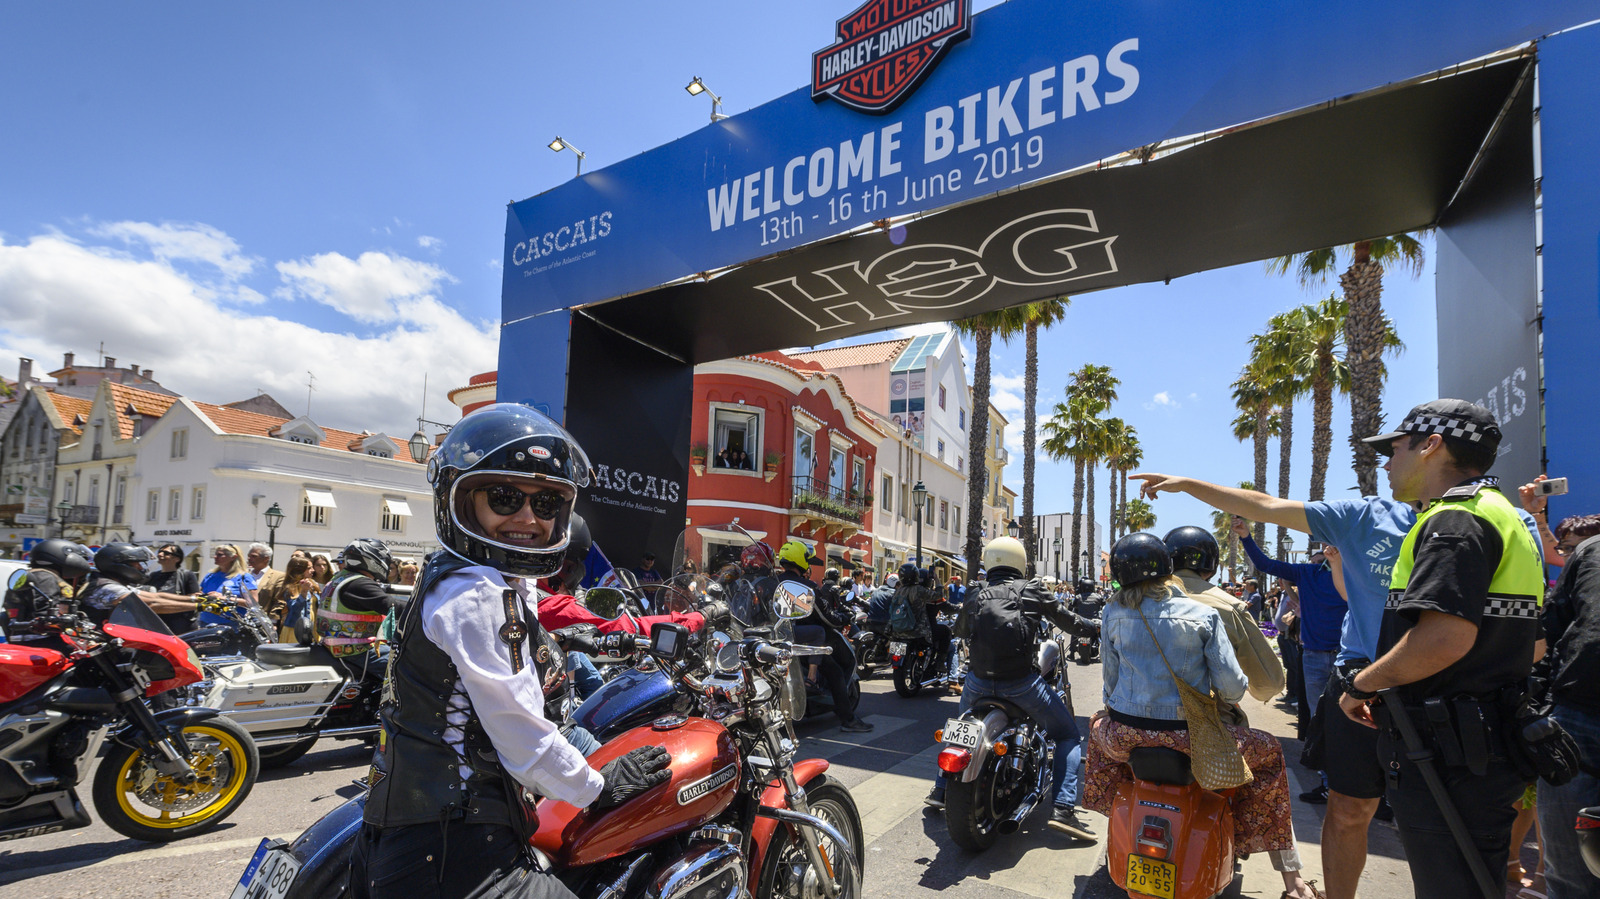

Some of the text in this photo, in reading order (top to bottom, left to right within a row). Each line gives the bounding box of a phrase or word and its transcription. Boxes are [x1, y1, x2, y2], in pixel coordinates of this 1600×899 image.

[822, 1, 956, 82] HARLEY-DAVIDSON
[850, 49, 920, 96] CYCLES
[707, 38, 1140, 232] WELCOME BIKERS
[760, 211, 803, 247] 13th
[828, 193, 852, 225] 16
[861, 185, 888, 213] th
[897, 167, 962, 206] June
[973, 135, 1044, 185] 2019
[512, 211, 613, 266] CASCAIS
[753, 208, 1120, 332] HOG
[596, 463, 680, 503] ASCAIS
[591, 494, 601, 502] The
[602, 496, 621, 506] Charm
[635, 503, 653, 512] Atlantic
[653, 506, 667, 514] Coast
[386, 540, 423, 548] DOMINGU
[1366, 536, 1393, 558] BUY
[1369, 562, 1393, 576] TAK
[508, 631, 522, 639] HOG
[272, 685, 307, 694] DEPUTY
[945, 731, 976, 746] JM-60
[956, 722, 970, 734] 25
[682, 766, 735, 801] HARLEY-DAVIDSON
[259, 851, 294, 894] 4188
[1130, 861, 1172, 880] 2-BRR
[1131, 873, 1172, 892] 20-55
